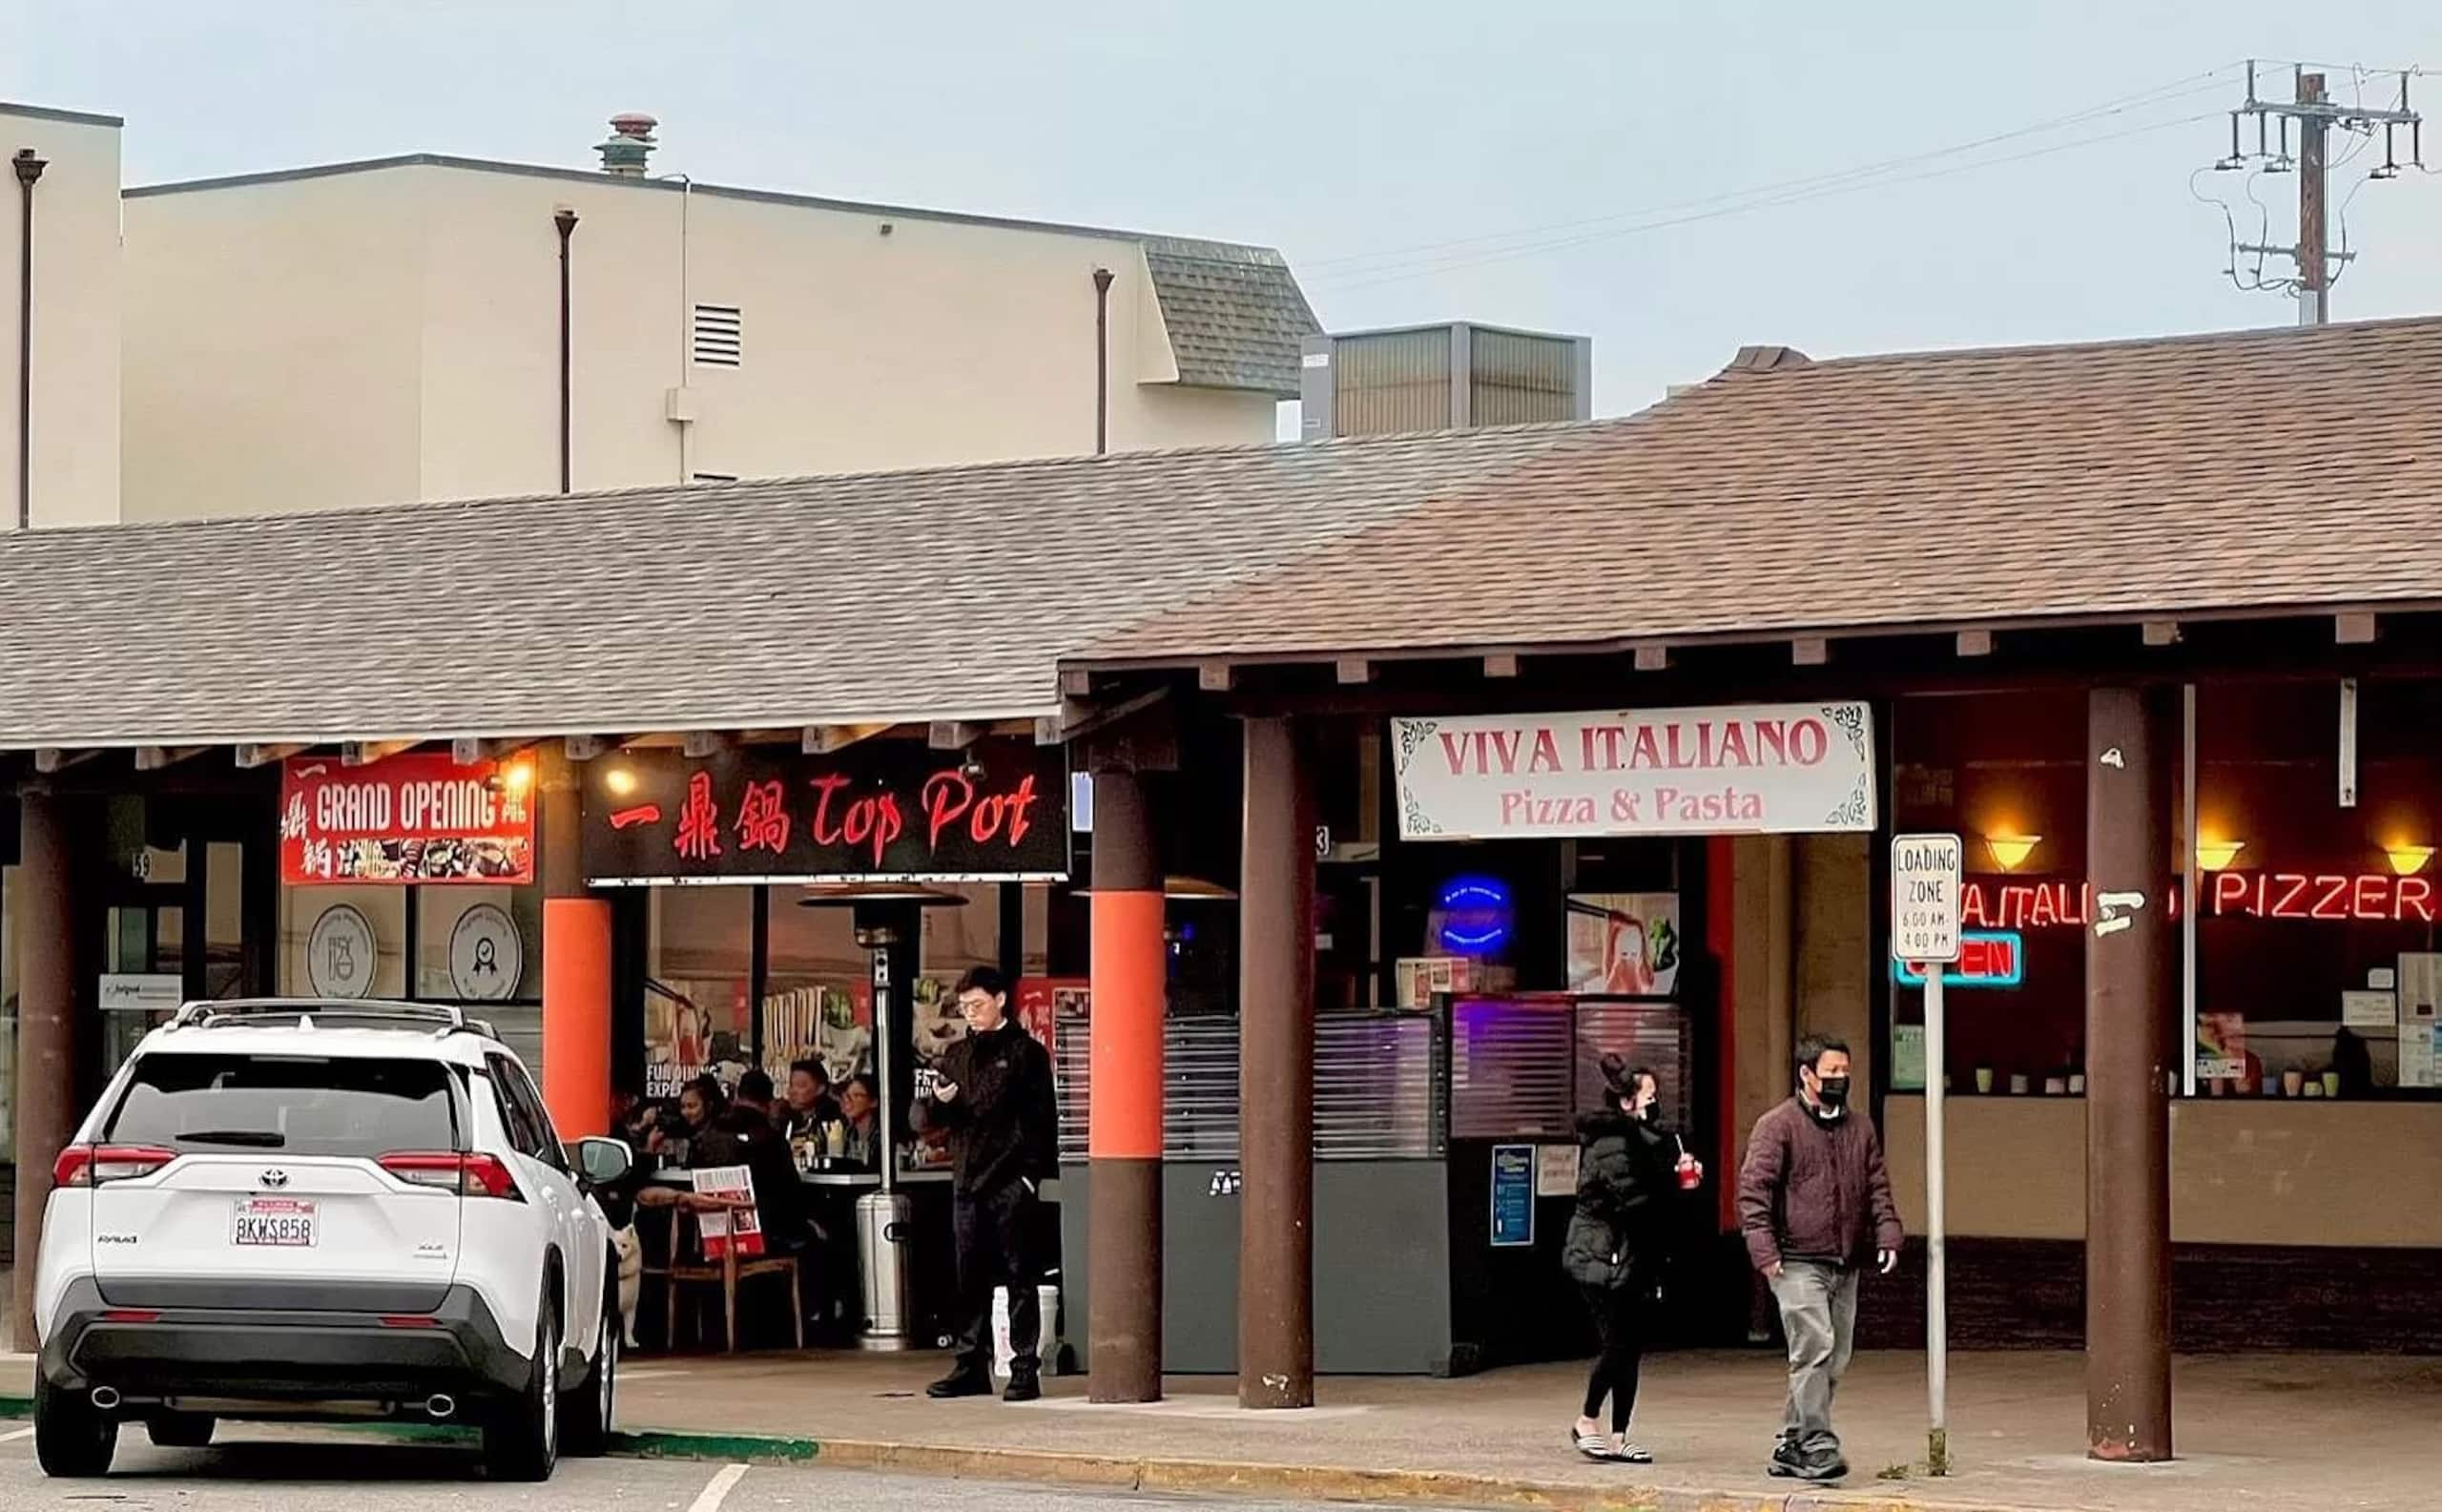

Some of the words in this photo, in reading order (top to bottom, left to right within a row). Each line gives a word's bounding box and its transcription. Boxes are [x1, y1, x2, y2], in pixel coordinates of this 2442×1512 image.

[1439, 728, 1563, 776] VIVA
[1580, 718, 1829, 772] ITALIANO
[317, 782, 391, 831] GRAND
[400, 779, 496, 831] OPENING
[809, 772, 902, 870] Top
[921, 770, 1038, 857] Pot
[1500, 791, 1597, 826] Pizza
[1609, 789, 1642, 823] &
[1654, 786, 1764, 821] Pasta
[1896, 848, 1956, 872] LOADING
[1908, 880, 1944, 903] ZONE
[1934, 932, 1949, 947] PM
[237, 1217, 311, 1238] 8KWS858
